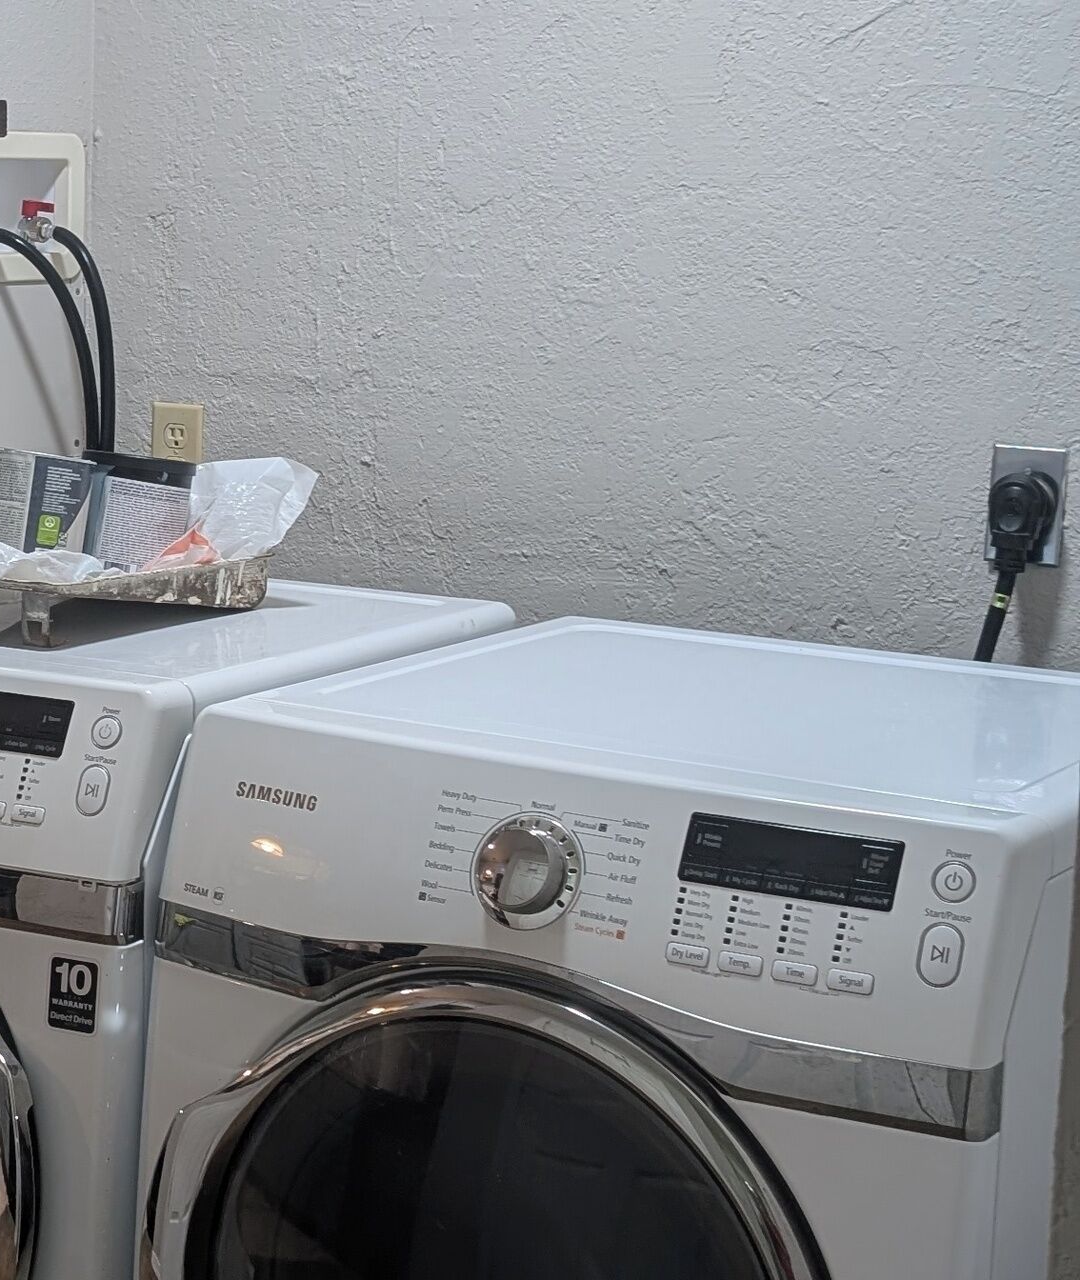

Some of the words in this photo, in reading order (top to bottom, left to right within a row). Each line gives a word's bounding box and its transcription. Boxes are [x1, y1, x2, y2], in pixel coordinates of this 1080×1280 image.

[102, 706, 121, 714] Power
[84, 753, 117, 765] Start/Pause
[236, 781, 318, 811] SAMSUNG
[441, 789, 461, 800] Heavy
[461, 792, 477, 802] Duty
[437, 804, 454, 814] Perm
[455, 807, 472, 817] Press
[531, 801, 556, 811] Normal
[18, 808, 36, 819] Signal
[434, 821, 456, 832] Towels
[574, 820, 597, 830] Manual
[622, 819, 650, 830] Sanitize
[428, 840, 456, 853] Bedding
[614, 833, 631, 845] Time
[633, 837, 646, 848] Dry
[607, 851, 627, 863] Quick
[628, 855, 641, 866] Dry
[945, 849, 972, 860] Power
[424, 860, 453, 872] Delicates
[421, 879, 438, 889] Wool
[608, 872, 619, 882] Air
[621, 874, 637, 885] Fluff
[184, 883, 209, 897] STEAM
[427, 893, 447, 904] Sensor
[605, 893, 633, 905] Refresh
[580, 909, 606, 922] Wrinkle
[608, 915, 628, 927] Away
[924, 907, 972, 923] Start/Pause
[574, 922, 594, 933] Steam
[595, 927, 614, 937] Cycles
[671, 947, 683, 959] Dry
[685, 950, 704, 961] Level
[728, 956, 751, 970] Temp.
[785, 966, 805, 978] Time
[55, 962, 92, 996] 10
[839, 975, 864, 987] Signal
[51, 998, 93, 1011] WARRANTY
[50, 1011, 72, 1022] Direct
[73, 1014, 93, 1026] Drive
